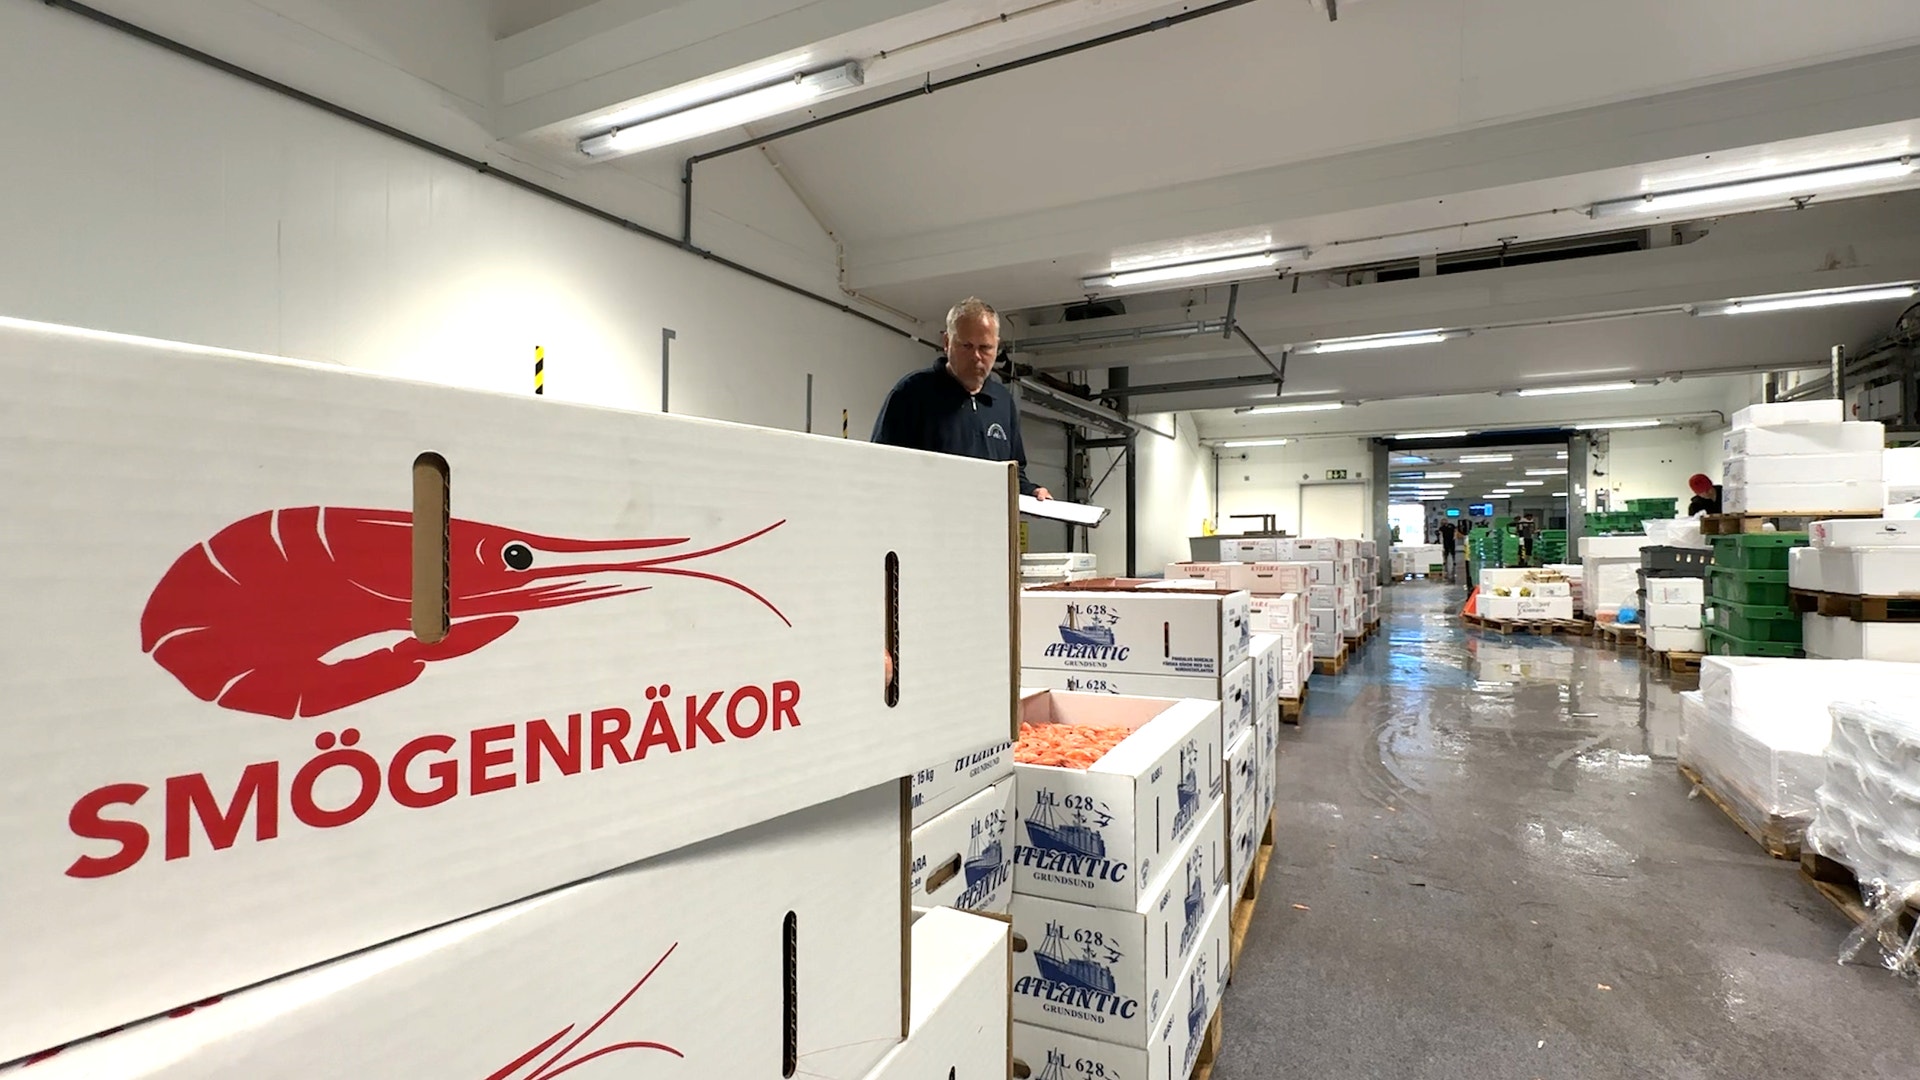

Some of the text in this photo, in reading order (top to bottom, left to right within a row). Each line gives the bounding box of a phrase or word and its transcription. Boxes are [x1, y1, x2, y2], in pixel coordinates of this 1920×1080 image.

[1087, 605, 1107, 614] 628
[1044, 643, 1130, 661] ATLANTIC
[1064, 660, 1108, 668] GRUNDSUND
[1087, 680, 1107, 690] 628
[65, 681, 801, 879] SMÖGENRÄKOR
[1065, 795, 1094, 810] 628
[985, 808, 1000, 829] 628
[1014, 845, 1128, 882] ATLANTIC
[1033, 872, 1095, 889] GRUNDSUND
[1074, 928, 1103, 945] 628
[1014, 975, 1138, 1019] ATLANTIC
[1043, 1004, 1105, 1023] GRUNDSUND
[1075, 1059, 1104, 1076] 628
